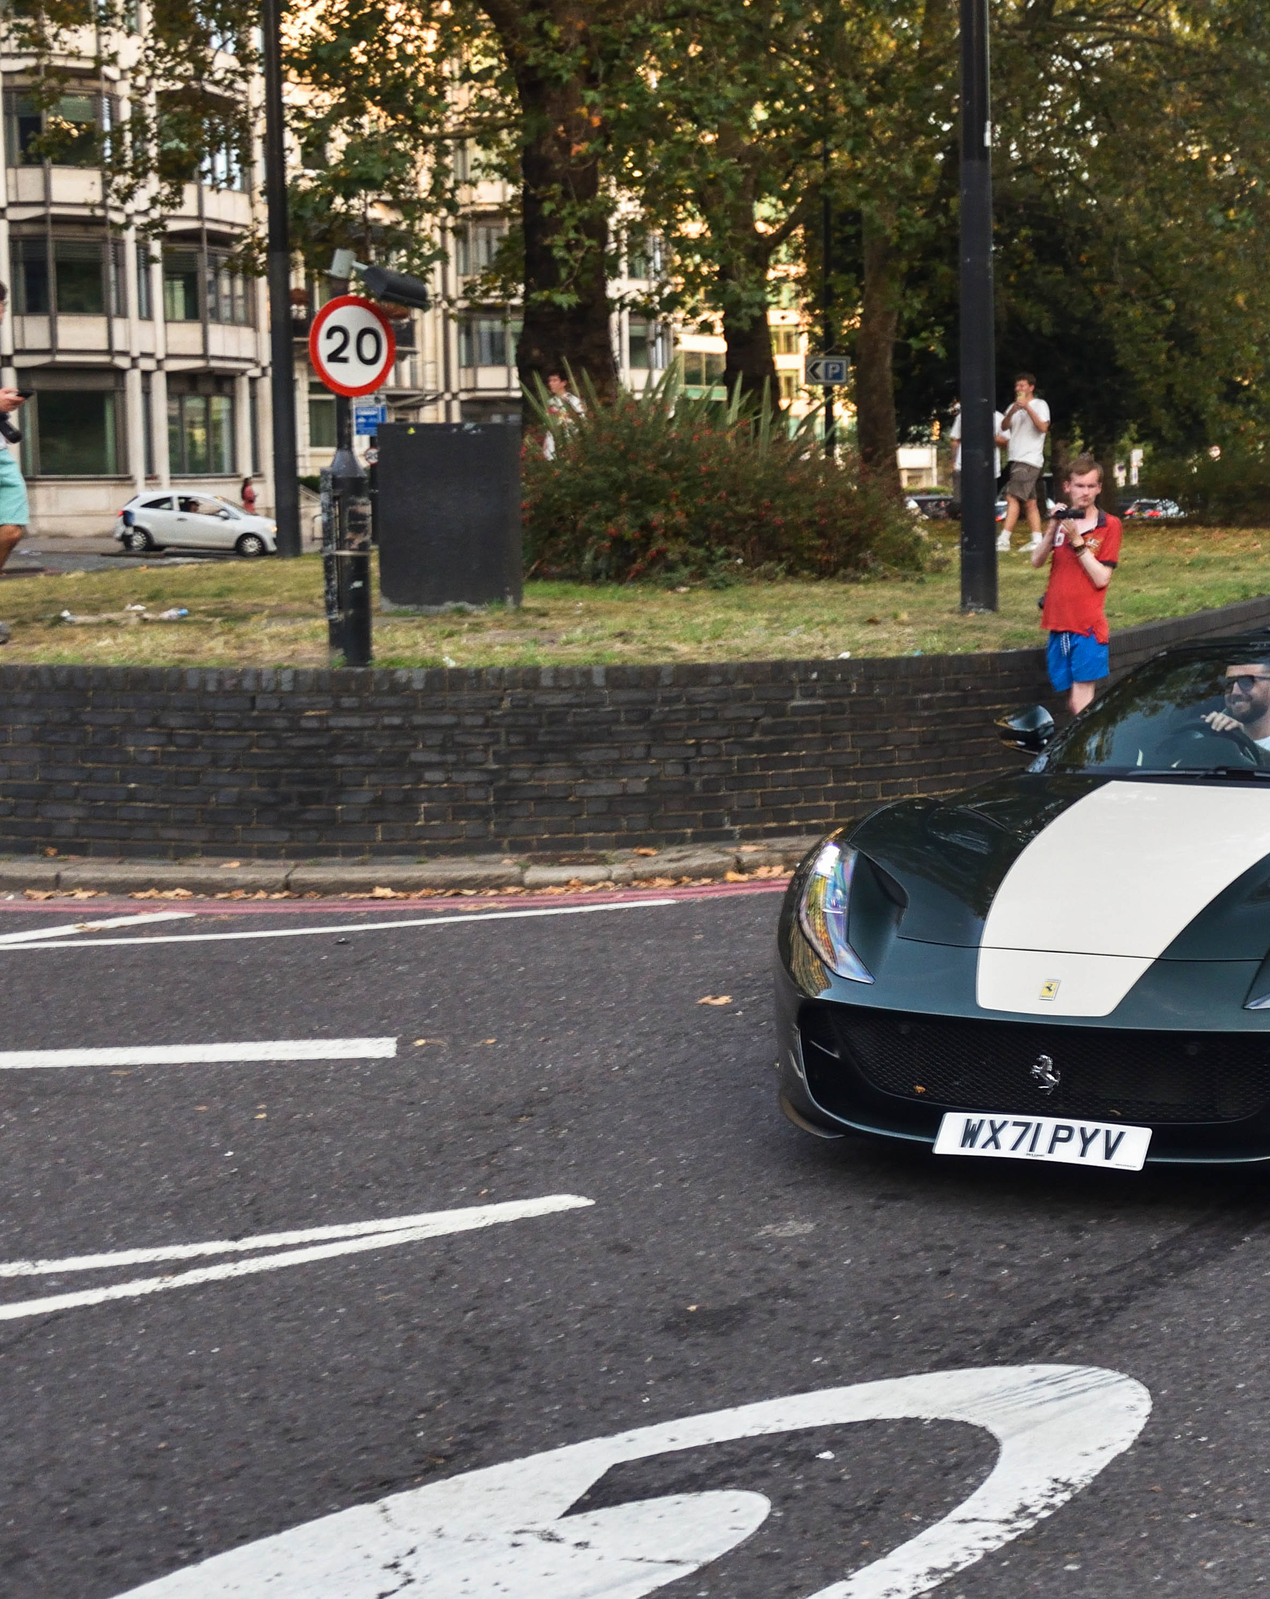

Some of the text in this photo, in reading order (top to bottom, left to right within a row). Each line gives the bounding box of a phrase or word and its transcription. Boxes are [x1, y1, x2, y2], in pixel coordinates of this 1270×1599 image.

[325, 324, 382, 366] 20
[829, 363, 840, 379] P
[960, 1118, 1126, 1161] WX71 PYV
